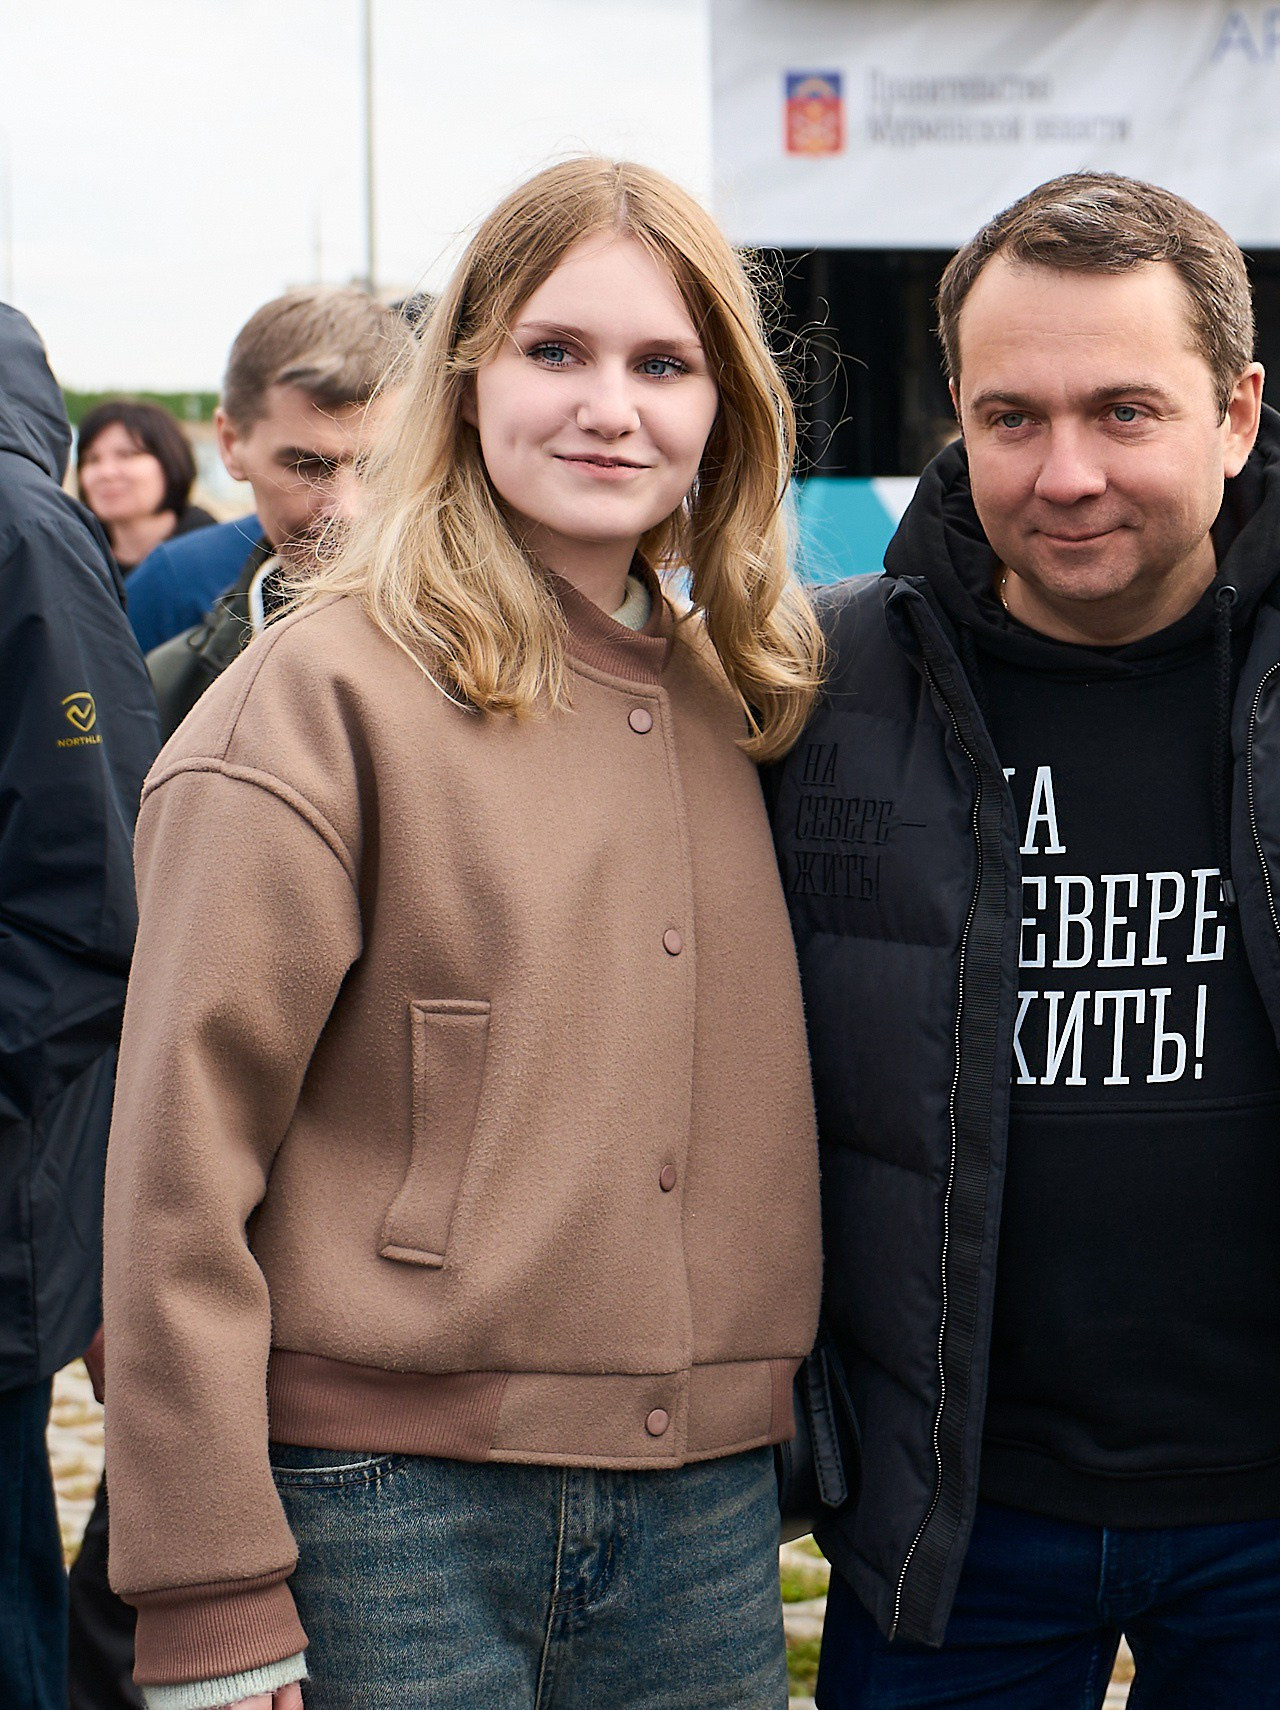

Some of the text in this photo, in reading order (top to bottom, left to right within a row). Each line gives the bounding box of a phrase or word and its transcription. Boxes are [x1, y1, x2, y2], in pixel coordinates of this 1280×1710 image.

[801, 743, 838, 786] НА
[795, 795, 894, 845] СЕВЕРЕ
[1002, 766, 1066, 854] А
[1018, 868, 1227, 968] ЕВЕРЕ
